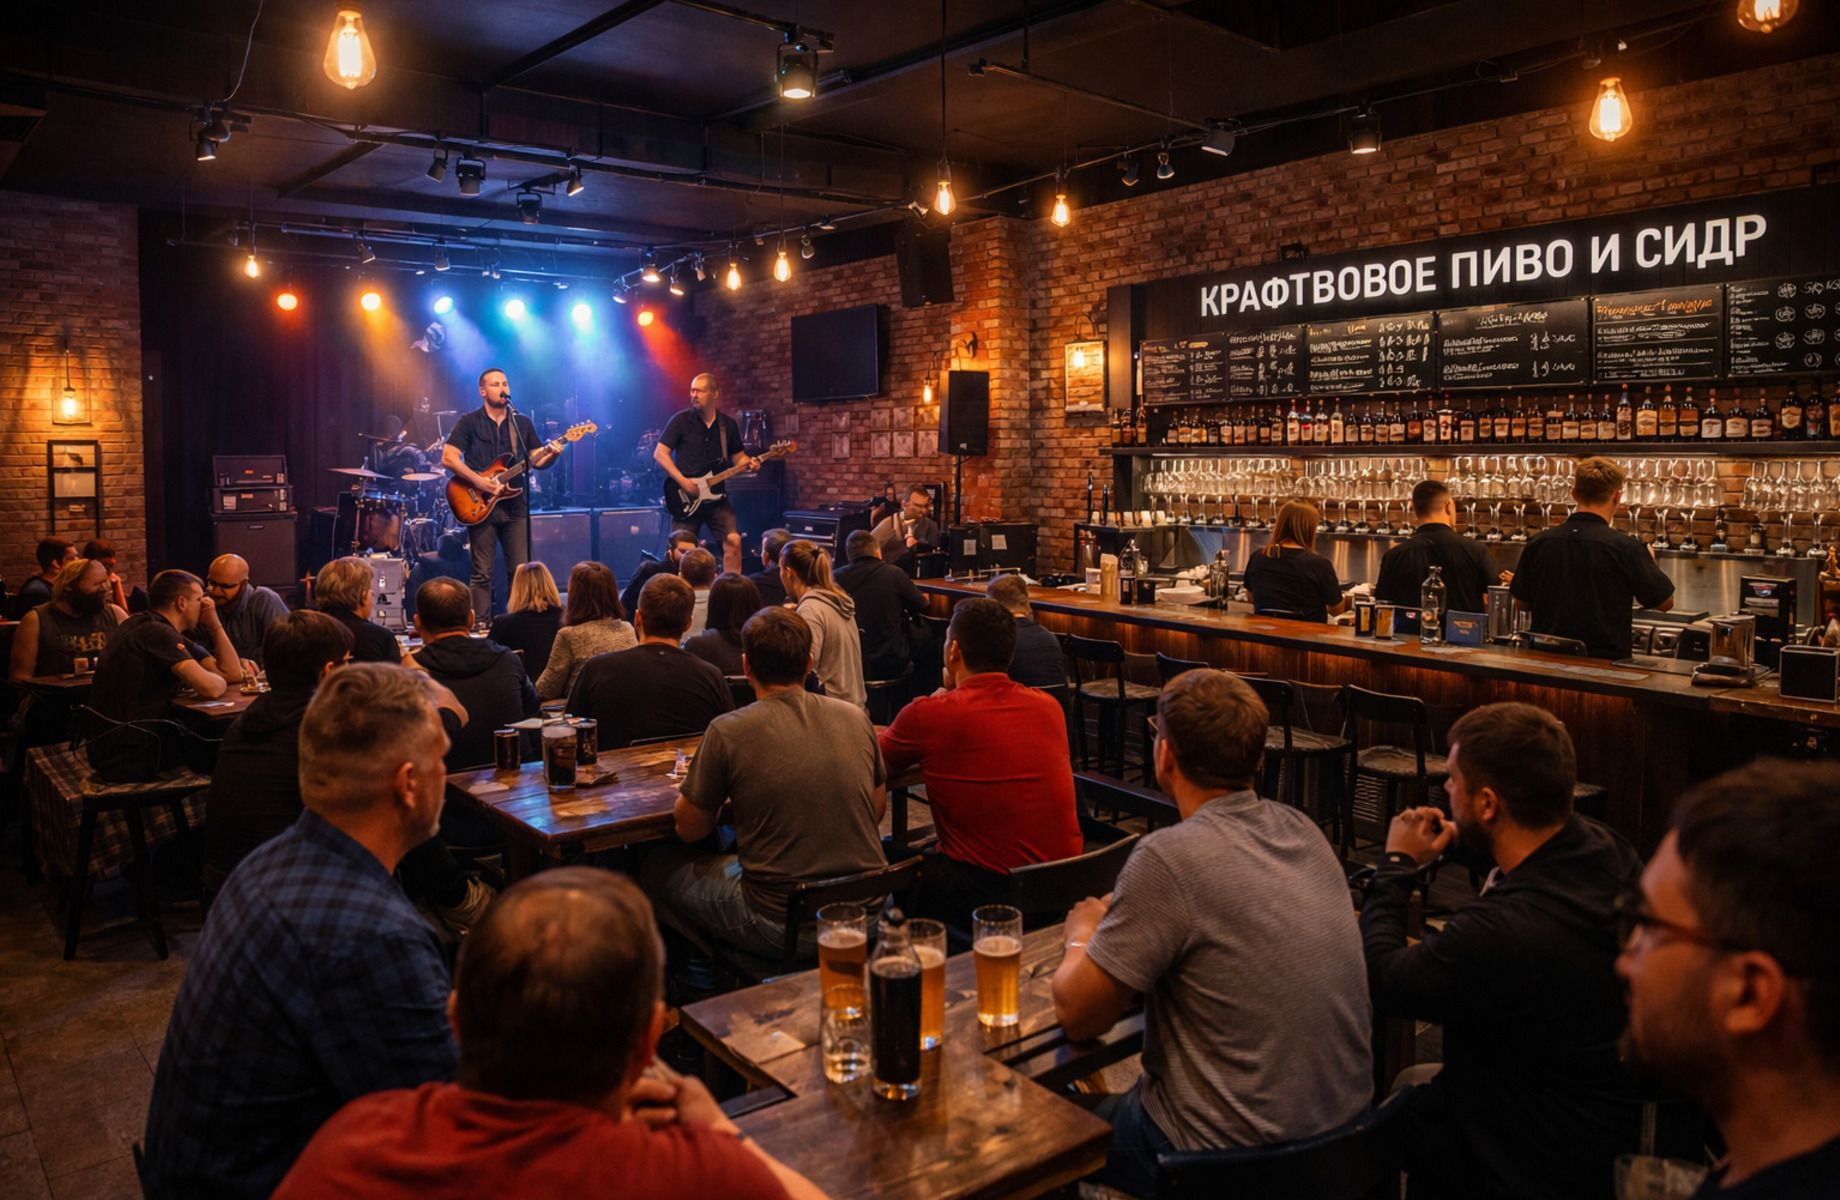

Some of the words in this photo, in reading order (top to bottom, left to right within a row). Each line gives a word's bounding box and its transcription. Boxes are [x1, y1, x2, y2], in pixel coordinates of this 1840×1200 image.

[1201, 256, 1437, 317] КРАФТВОВОЕ
[1451, 240, 1574, 289] ПИВО
[1591, 233, 1620, 274] И
[1635, 215, 1767, 269] СИДР
